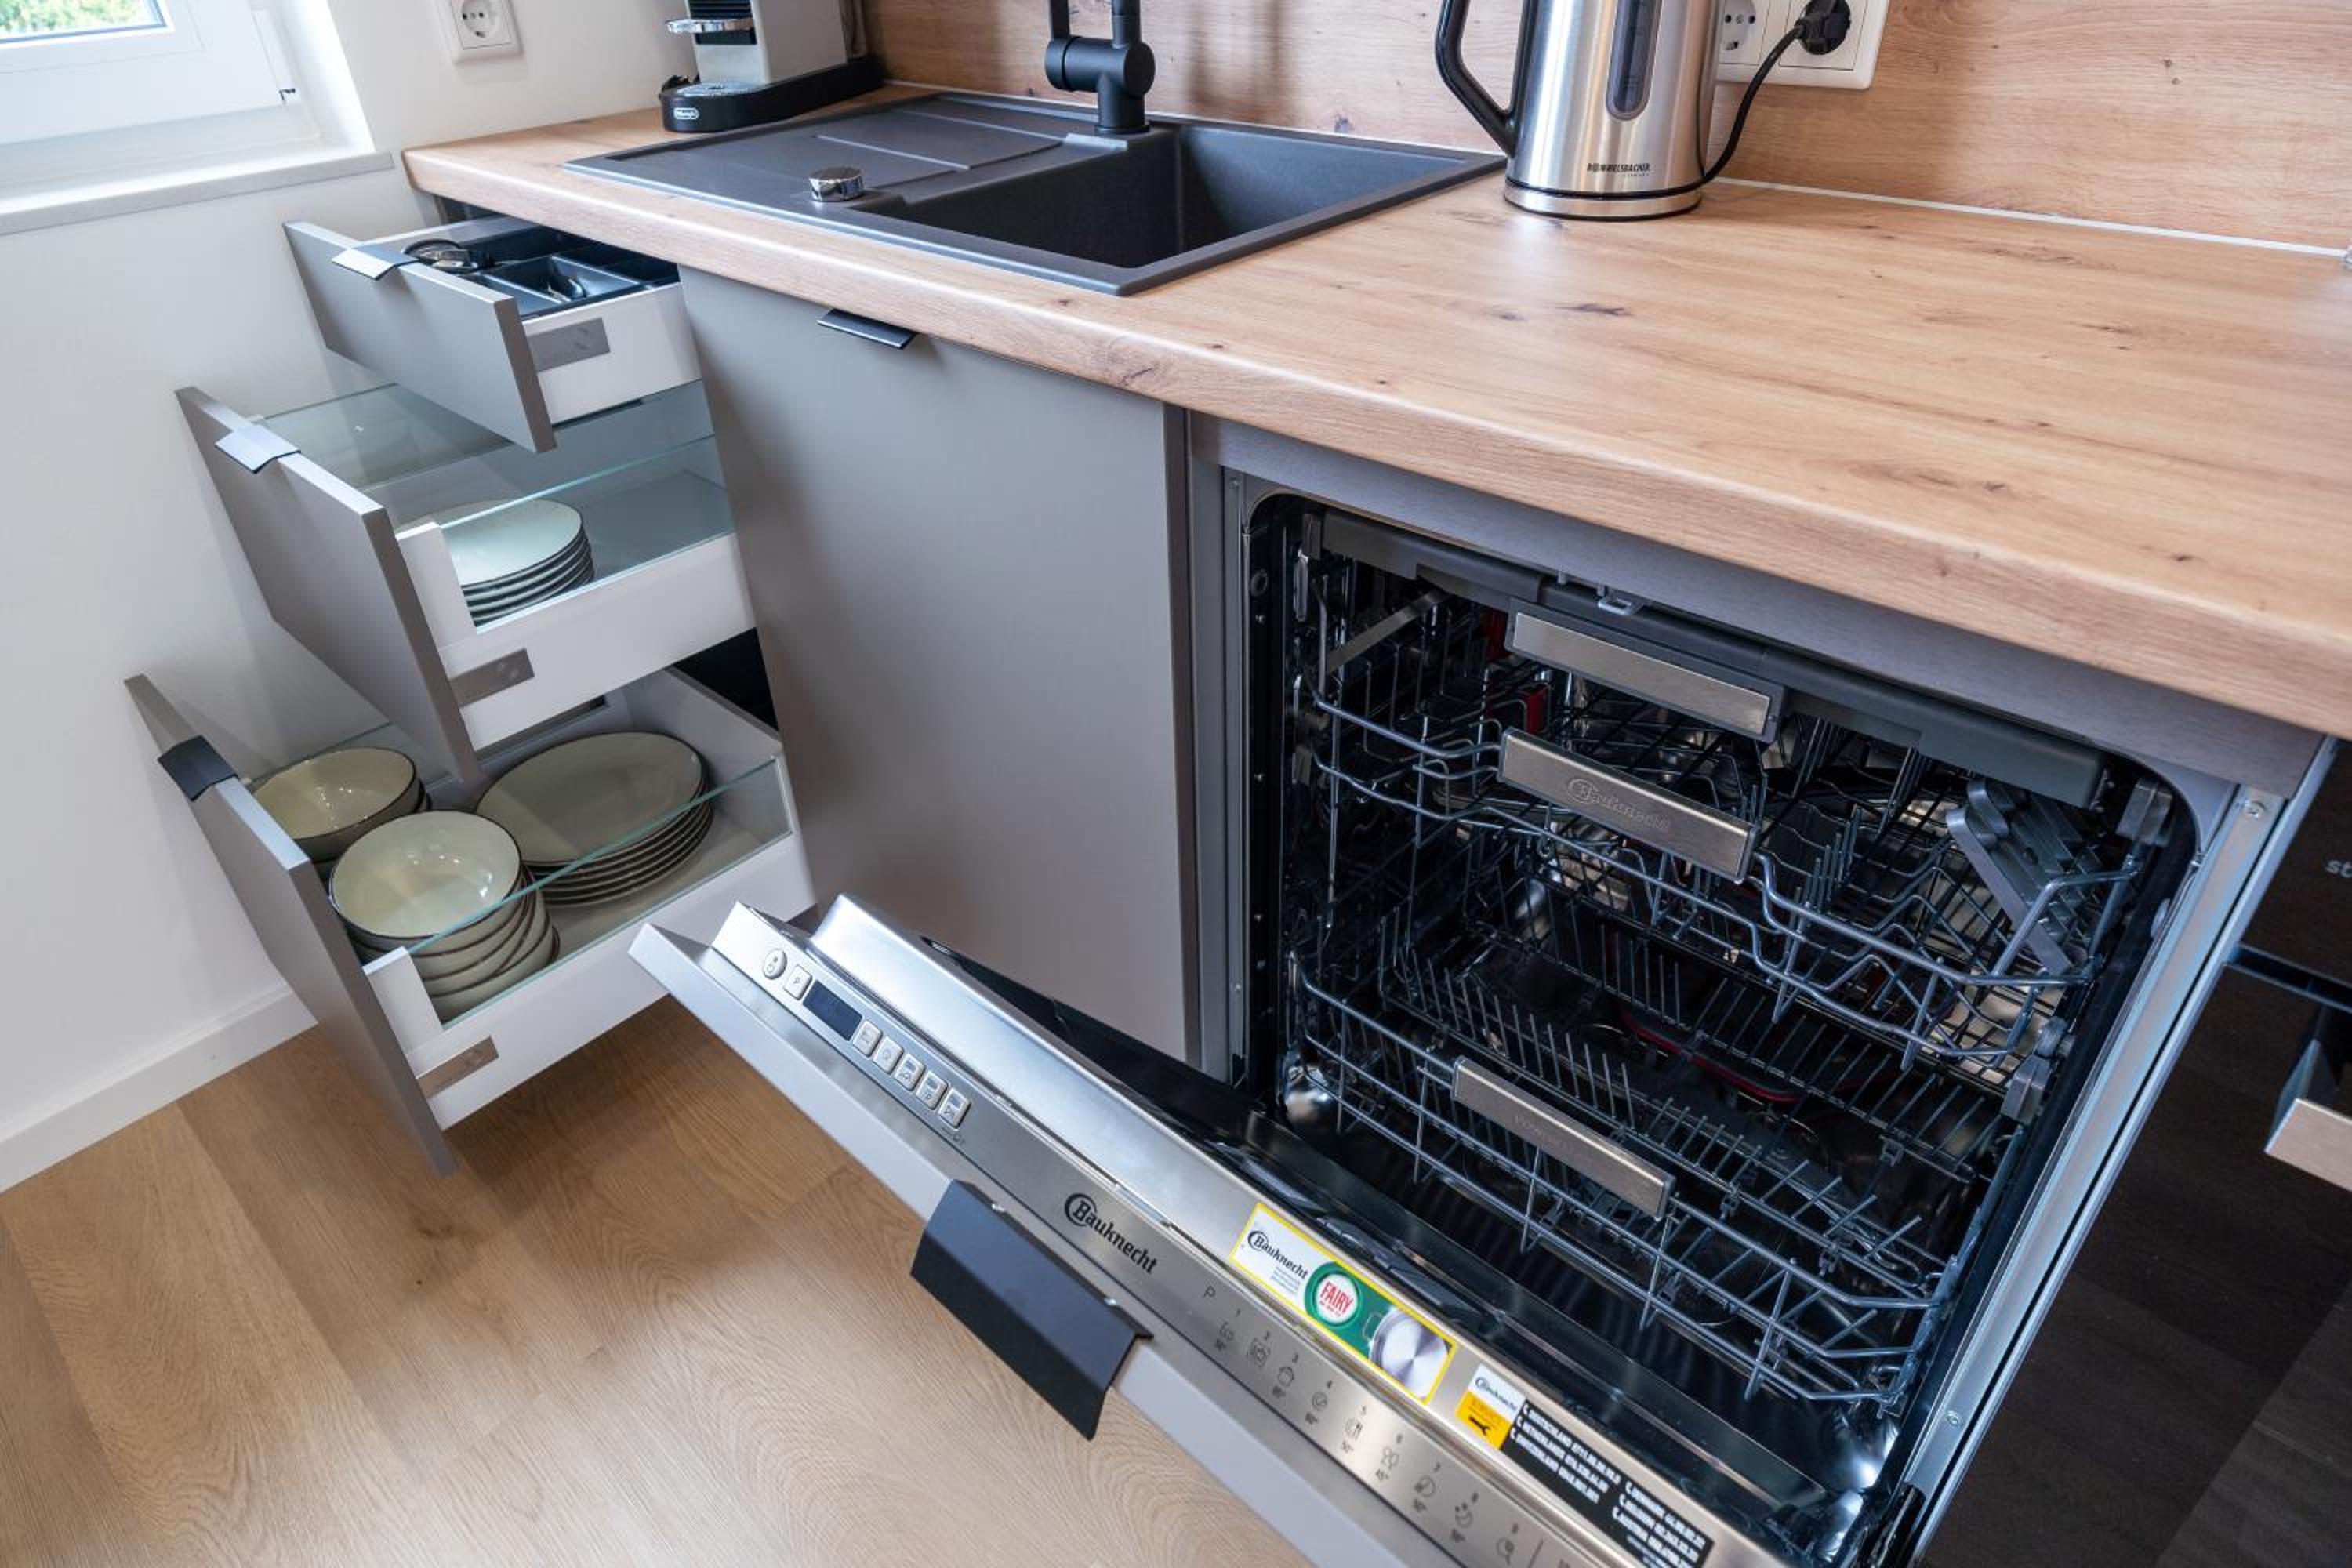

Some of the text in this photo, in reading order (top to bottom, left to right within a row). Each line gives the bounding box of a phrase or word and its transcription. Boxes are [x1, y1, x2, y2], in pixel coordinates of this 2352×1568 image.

[1064, 1192, 1157, 1274] Bauknecht
[1247, 1229, 1309, 1279] Bauknecht
[1203, 1285, 1215, 1298] P
[1319, 1281, 1354, 1314] FAIRY
